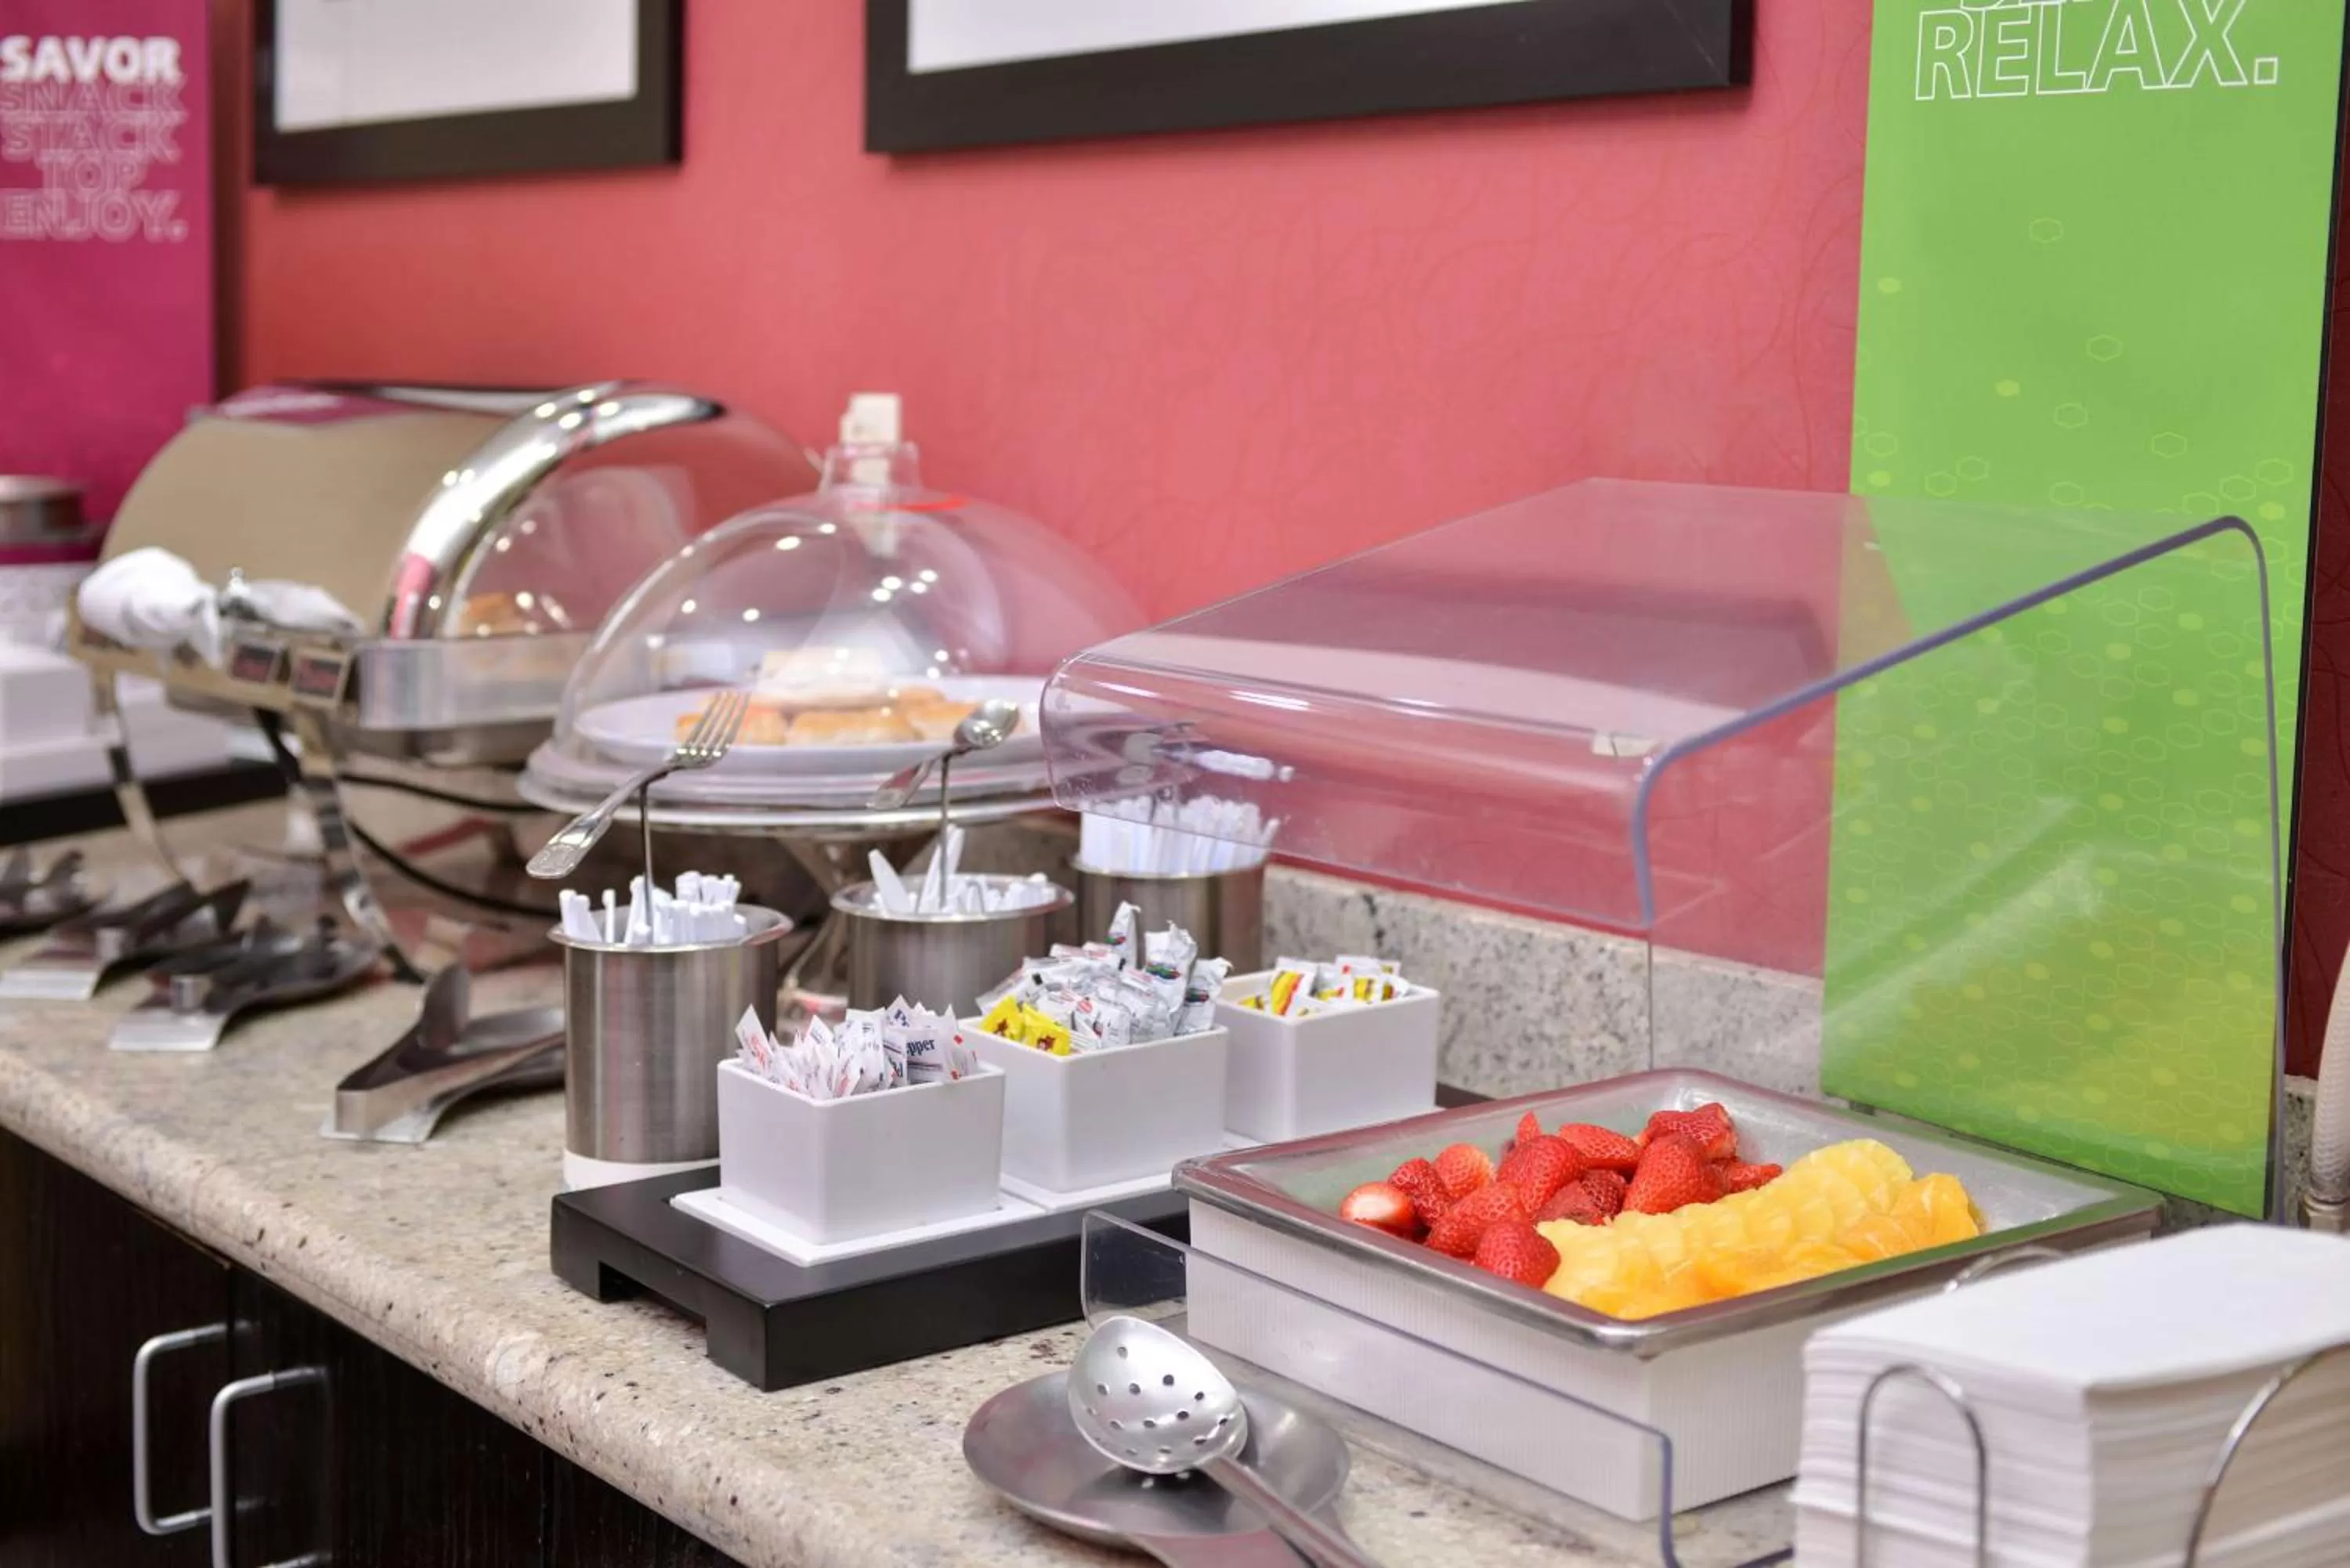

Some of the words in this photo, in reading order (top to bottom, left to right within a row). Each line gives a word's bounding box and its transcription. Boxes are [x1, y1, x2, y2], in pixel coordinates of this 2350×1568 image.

[0, 35, 182, 82] SAVOR
[1914, 0, 2278, 100] RELAX.
[2, 110, 182, 162] STACK
[35, 149, 147, 201] TOP
[0, 188, 188, 241] ENJOY.
